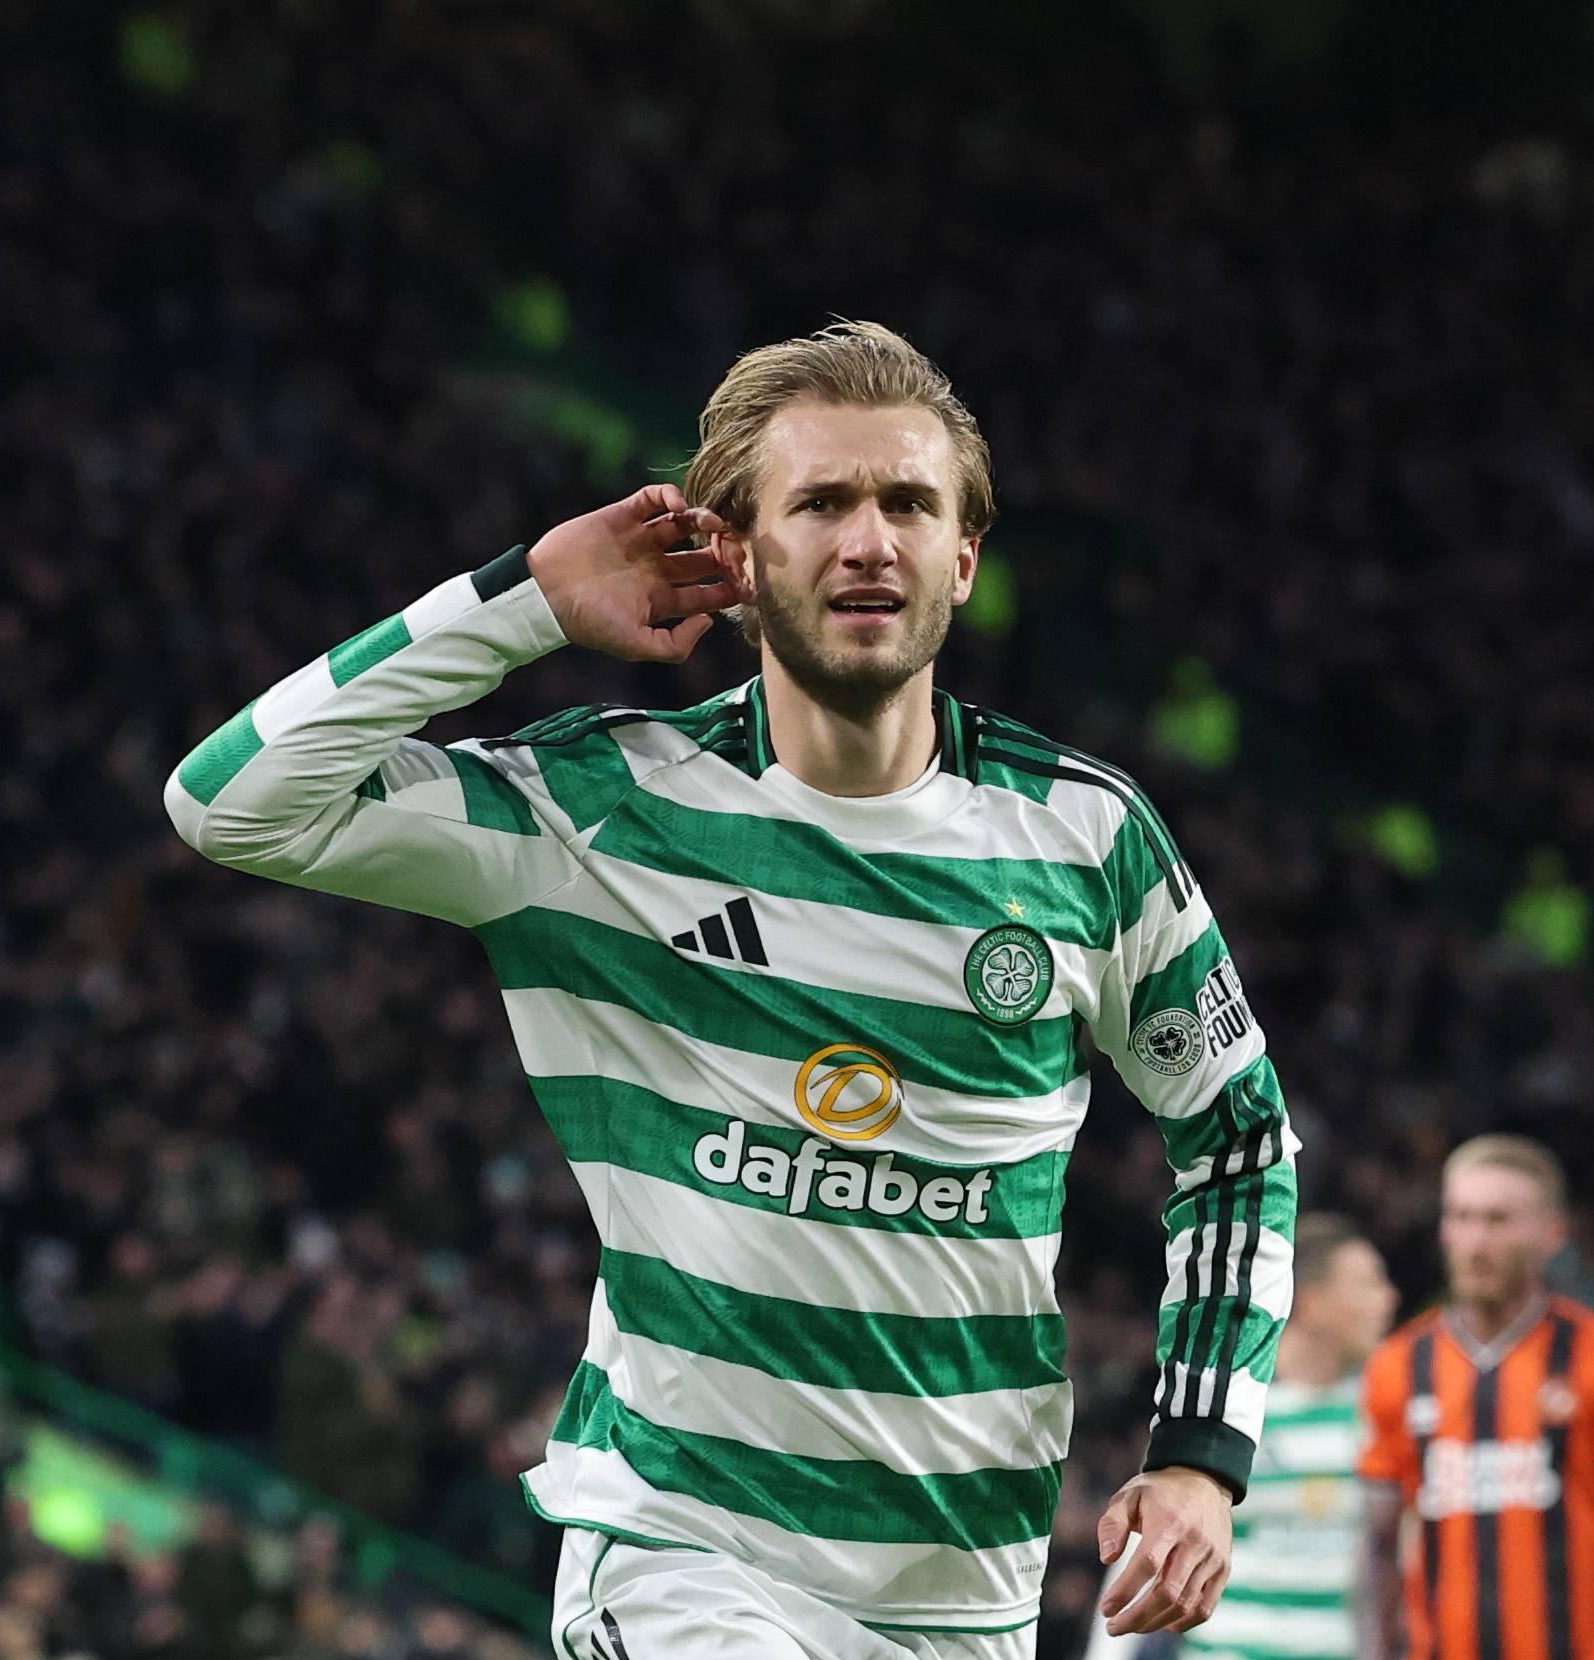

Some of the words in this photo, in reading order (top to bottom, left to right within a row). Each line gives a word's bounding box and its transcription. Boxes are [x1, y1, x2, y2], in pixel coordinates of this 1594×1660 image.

[969, 953, 984, 971] THE
[979, 932, 1004, 954] CELTIC
[1006, 931, 1040, 960] FOOTBALL
[1039, 956, 1050, 981] CLUB
[692, 1119, 993, 1225] dafabet
